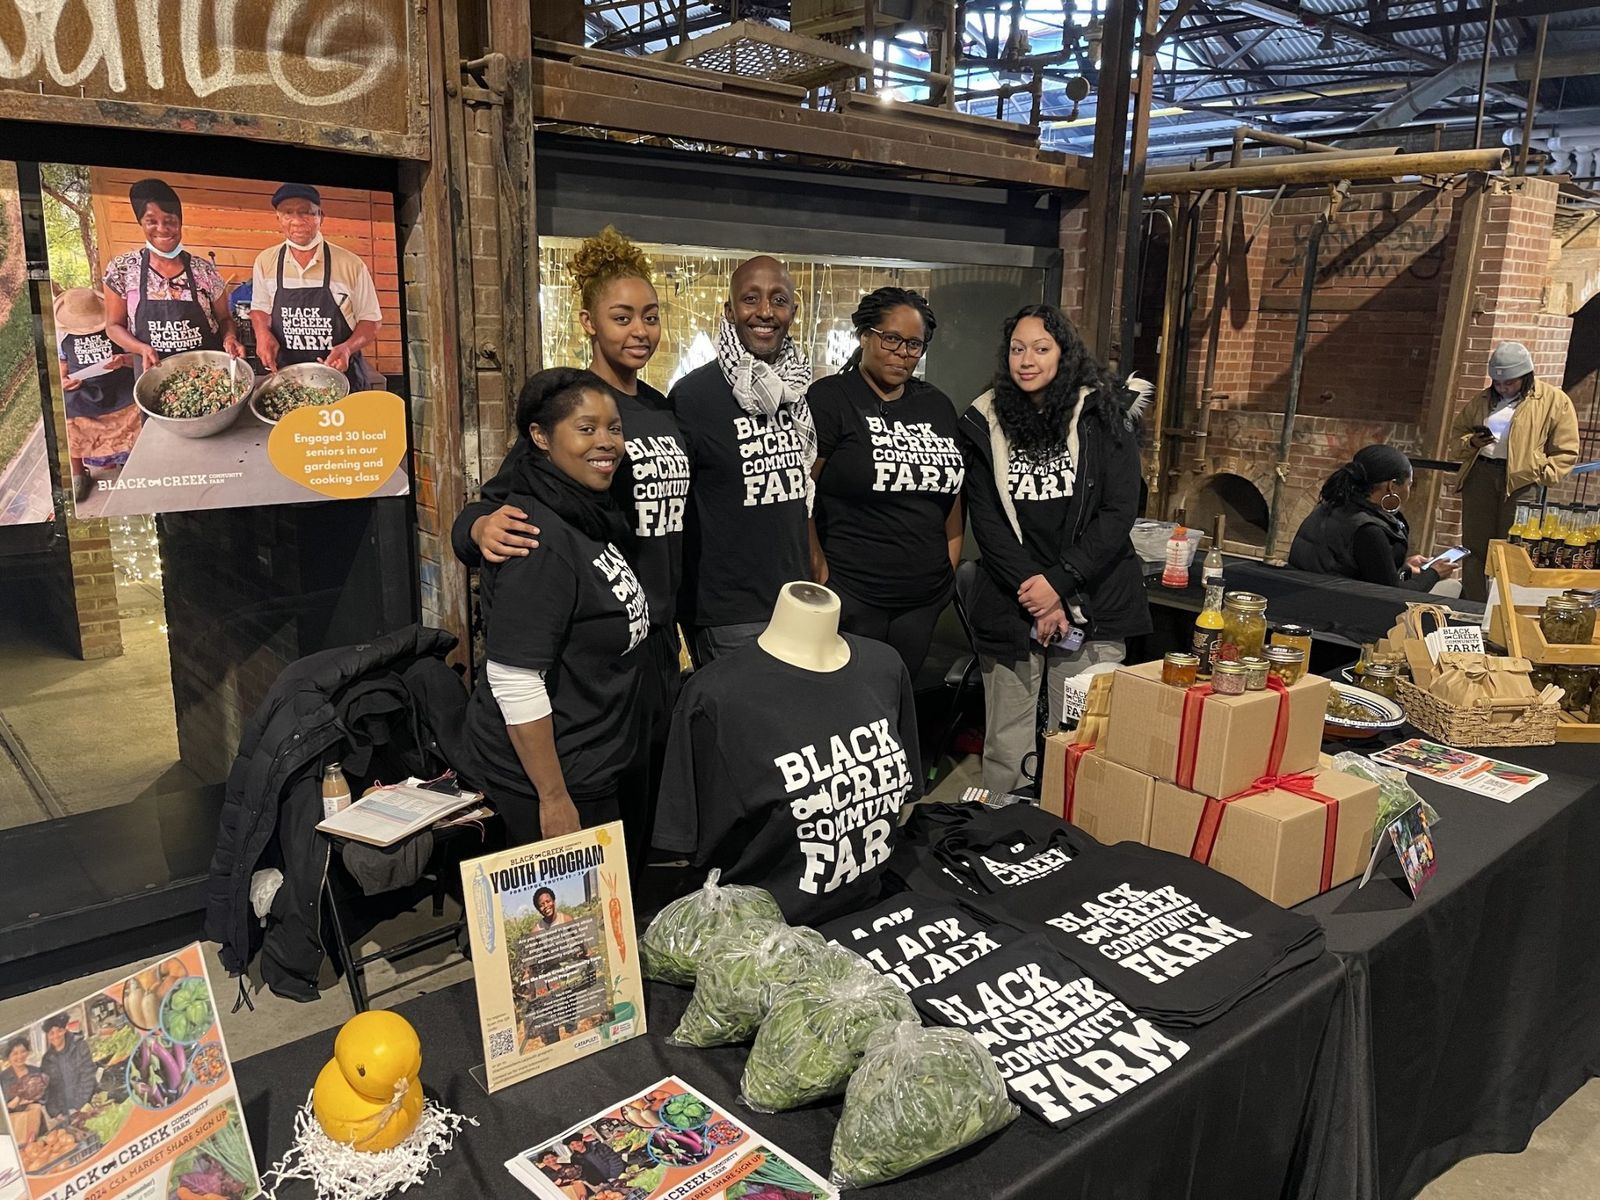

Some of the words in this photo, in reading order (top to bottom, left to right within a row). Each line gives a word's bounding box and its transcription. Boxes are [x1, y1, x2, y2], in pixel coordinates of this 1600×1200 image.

[281, 307, 320, 318] BLACK
[292, 317, 332, 328] CREEK
[148, 320, 190, 331] BLACK
[162, 327, 201, 340] CREEK
[283, 328, 332, 336] COMMUNITY
[74, 335, 102, 346] BLACK
[150, 337, 202, 348] COMMUNITY
[285, 335, 333, 350] FARM
[77, 352, 113, 364] FARM
[318, 410, 345, 427] 30
[733, 409, 794, 440] BLAC
[865, 416, 938, 438] BLACK
[294, 432, 342, 445] Engaged
[346, 431, 360, 441] 30
[362, 430, 387, 440] local
[624, 435, 686, 461] BLACK
[763, 429, 802, 455] CRE
[892, 434, 960, 454] CREEK
[305, 447, 344, 457] seniors
[347, 446, 357, 455] in
[359, 447, 378, 455] our
[873, 449, 964, 467] COMMUNITY
[304, 459, 360, 473] gardening
[363, 458, 383, 468] and
[97, 478, 147, 491] BLACK
[162, 474, 208, 487] CREEK
[310, 474, 352, 485] cooking
[355, 472, 380, 482] class
[872, 463, 965, 495] FARM
[1446, 644, 1481, 652] FARM
[773, 718, 900, 793] BLACK
[830, 749, 913, 812] CREE
[510, 854, 535, 866] BLACK
[542, 847, 564, 858] CREEK
[490, 865, 537, 894] YOUTH
[539, 844, 604, 881] PROGRAM
[1045, 882, 1149, 933] BLACK
[1099, 885, 1192, 935] CREEK
[1099, 903, 1208, 960] COMMUNITY
[867, 918, 966, 972] LACK
[1118, 916, 1253, 984] FARM
[926, 963, 1061, 1026] BLACK
[992, 977, 1116, 1041] CREEK
[993, 1001, 1137, 1079] COMMUNITY
[1007, 1018, 1191, 1123] FARM
[172, 1119, 191, 1134] FARM
[43, 1167, 100, 1200] ACK
[118, 1124, 171, 1165] CREEK
[170, 1099, 209, 1126] COMMUNITY
[109, 1175, 127, 1190] CSA
[129, 1156, 164, 1178] MARKET
[166, 1135, 194, 1156] SHARE
[195, 1121, 215, 1137] SIGN
[216, 1110, 227, 1122] UP
[668, 1172, 711, 1200] CREEK
[708, 1152, 738, 1173] COMMUNITY
[712, 1166, 727, 1176] FARM
[712, 1173, 734, 1189] SHARE
[735, 1163, 750, 1175] SIGN
[752, 1154, 761, 1163] UP
